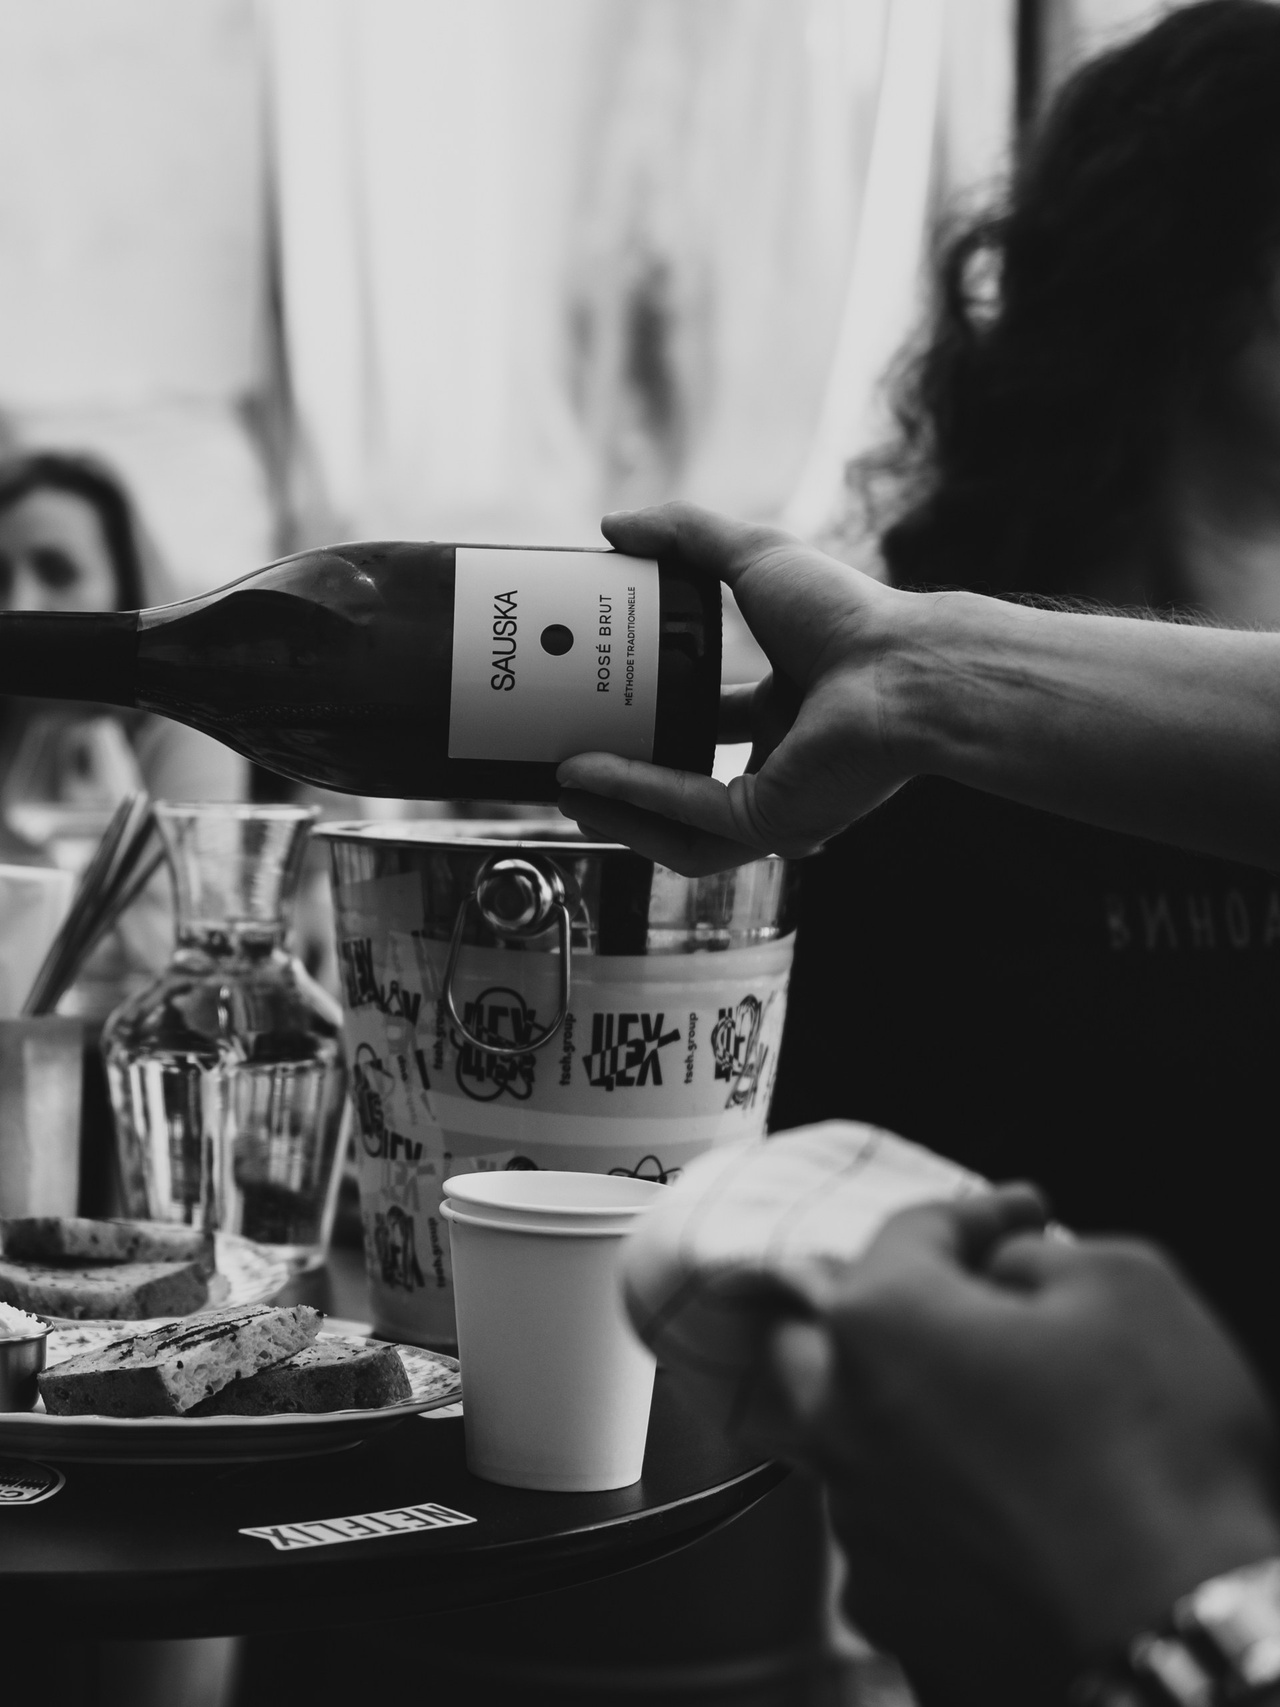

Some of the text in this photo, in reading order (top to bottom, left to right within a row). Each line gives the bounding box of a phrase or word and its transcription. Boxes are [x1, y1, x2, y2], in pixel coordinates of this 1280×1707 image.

[490, 590, 518, 692] SAUSKA
[595, 594, 612, 692] ROSÉ BRUT
[624, 586, 636, 706] MÉTHODE TRADITIONNELLE
[559, 1012, 577, 1086] tseh.group
[583, 1013, 681, 1091] ЦЕХ
[684, 1012, 698, 1085] tseh.group
[250, 1504, 470, 1547] NETFLIX
